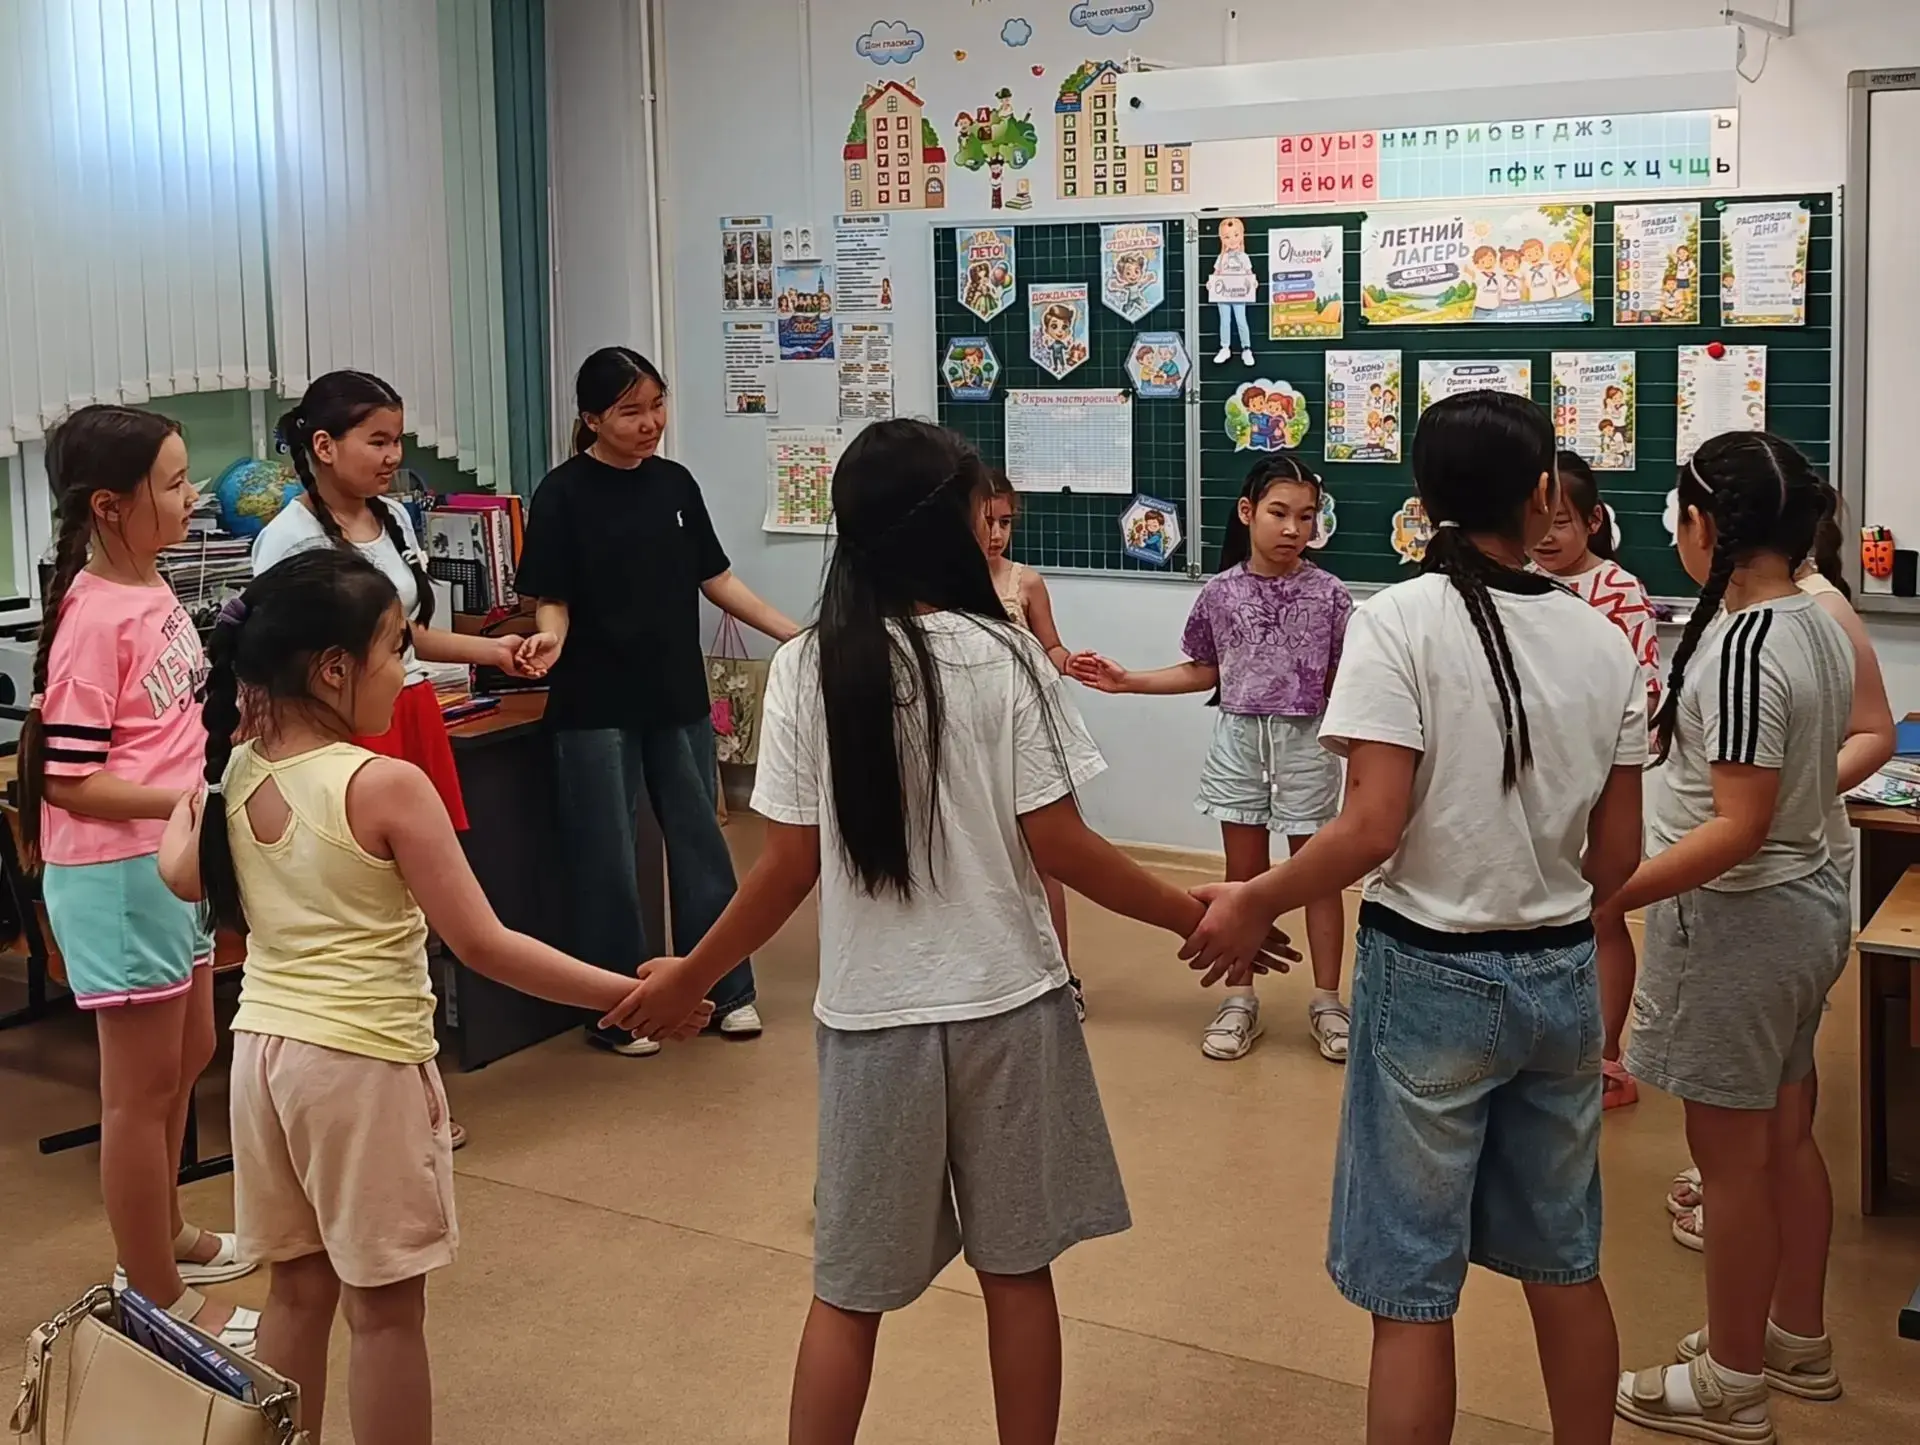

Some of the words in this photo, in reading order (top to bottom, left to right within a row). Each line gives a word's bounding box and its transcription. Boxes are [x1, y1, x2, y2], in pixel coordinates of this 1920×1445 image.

[1080, 9, 1098, 20] Дом
[1100, 4, 1146, 17] согласных
[1642, 215, 1678, 228] ПРАВИЛА
[1736, 211, 1792, 225] РАСПОРЯДОК
[1380, 217, 1464, 248] ЛЕТНИЙ
[1643, 226, 1676, 237] ЛАГЕРЯ
[1752, 222, 1779, 237] ДНЯ
[1392, 242, 1471, 267] ЛАГЕРЬ
[1351, 361, 1385, 375] ЗАКОНЫ
[1579, 363, 1616, 375] ПРАВИЛА
[1354, 372, 1383, 382] ОРЛЯТ
[1580, 372, 1617, 383] ГИГИЕНЫ
[1021, 392, 1054, 407] Экран
[1055, 393, 1119, 406] настроения
[161, 614, 179, 642] THE
[141, 621, 205, 720] NEW
